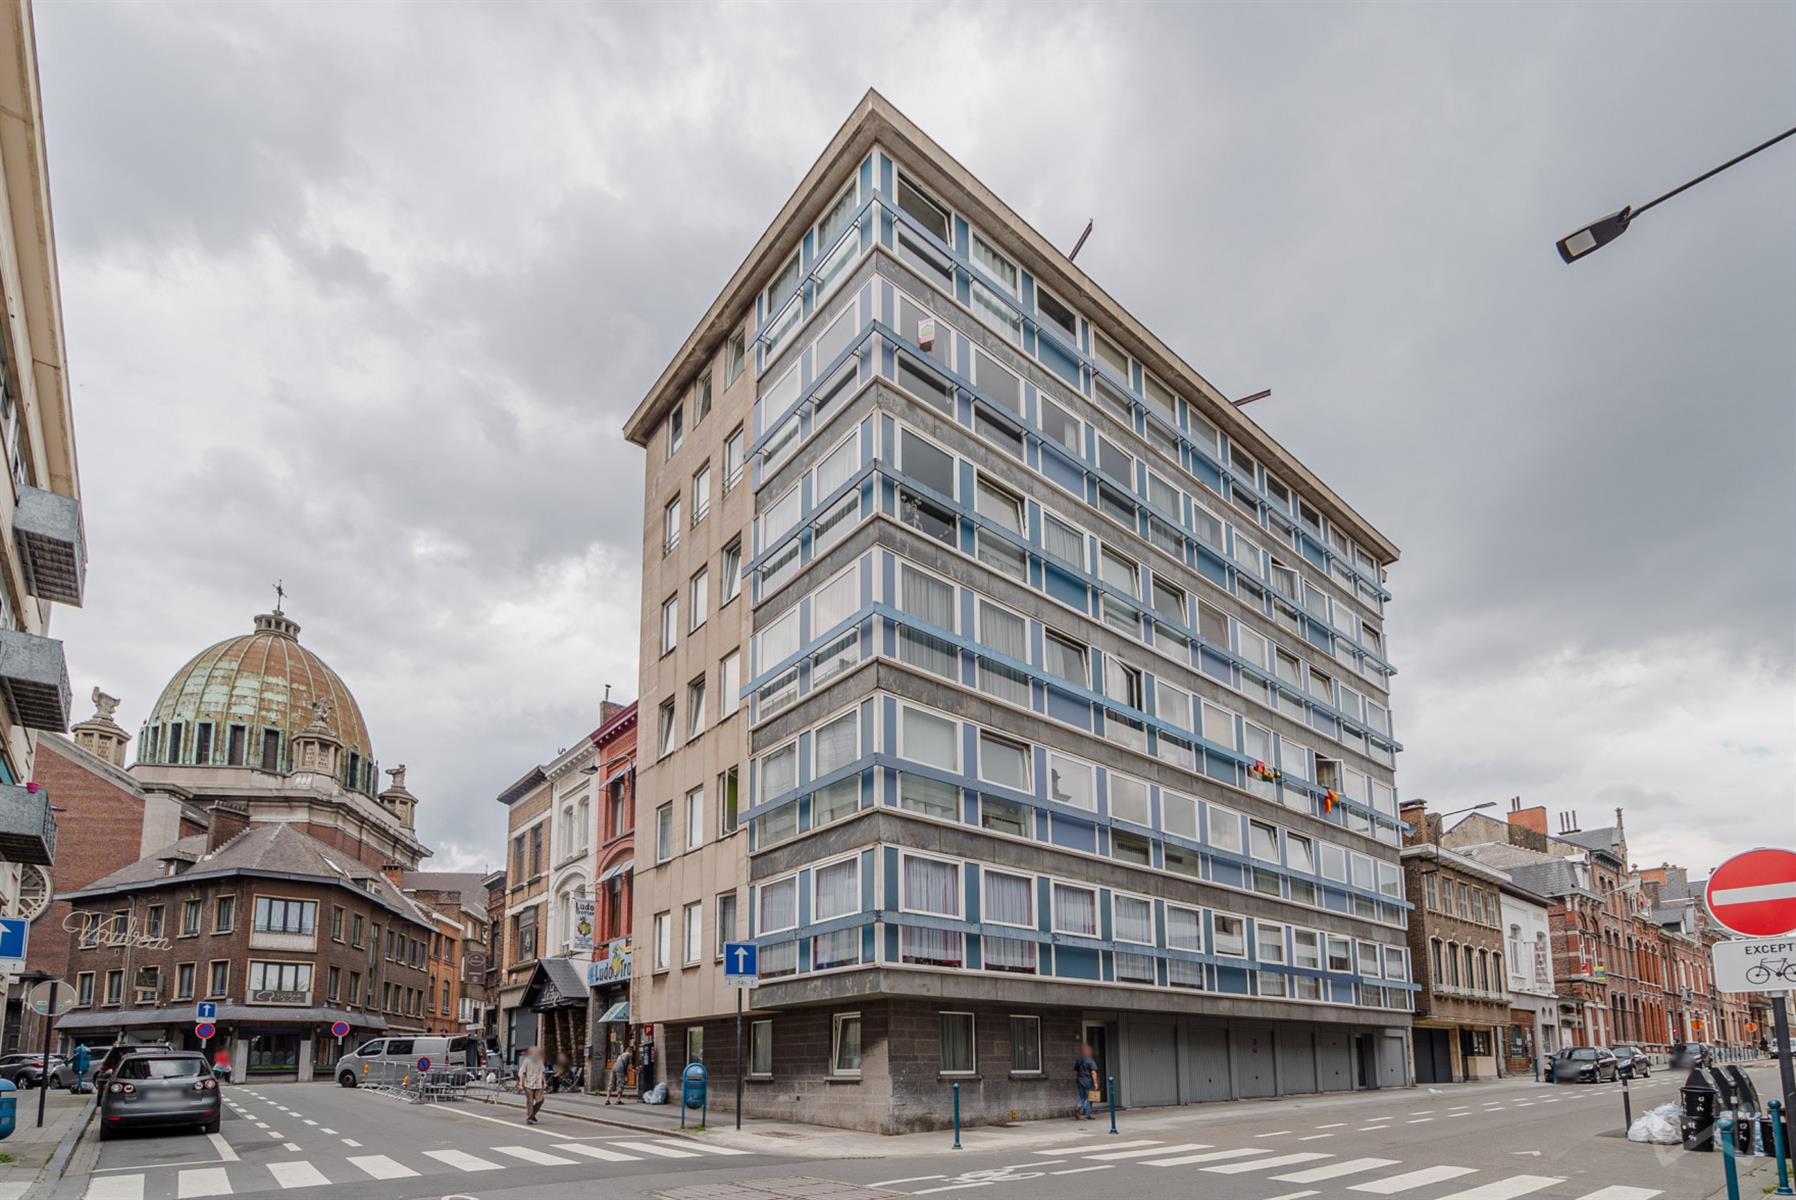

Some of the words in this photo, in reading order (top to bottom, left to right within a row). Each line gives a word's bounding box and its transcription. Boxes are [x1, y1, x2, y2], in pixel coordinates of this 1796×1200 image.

[576, 902, 595, 911] Ludo
[1745, 943, 1794, 955] EXCEPT
[595, 962, 614, 983] Ludo
